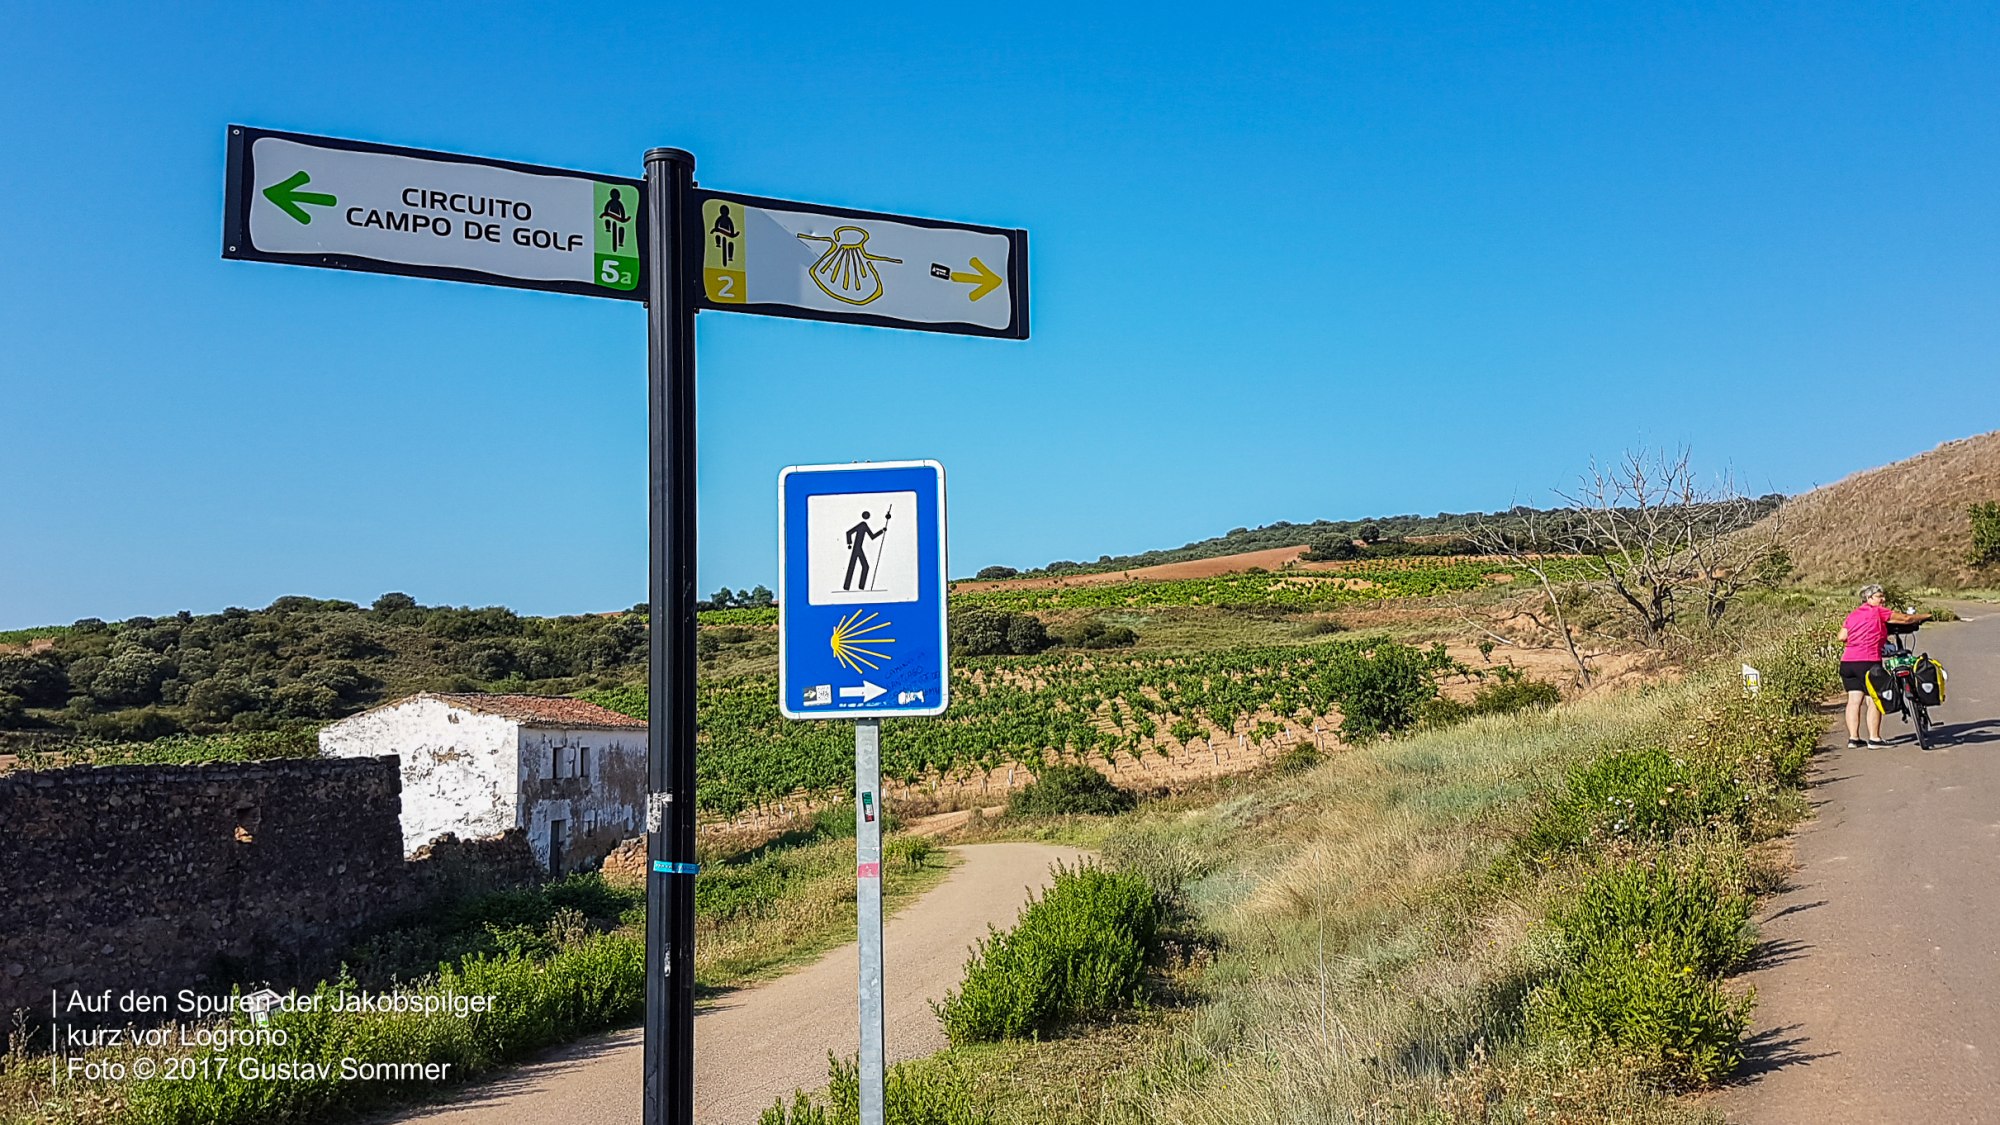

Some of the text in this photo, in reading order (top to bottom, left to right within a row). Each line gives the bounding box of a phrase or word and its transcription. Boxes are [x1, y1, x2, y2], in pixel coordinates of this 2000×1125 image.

[402, 187, 532, 221] CIRCUITO
[346, 206, 583, 252] CAMPO DE GOLF
[601, 259, 632, 285] 5a
[717, 275, 735, 298] 2
